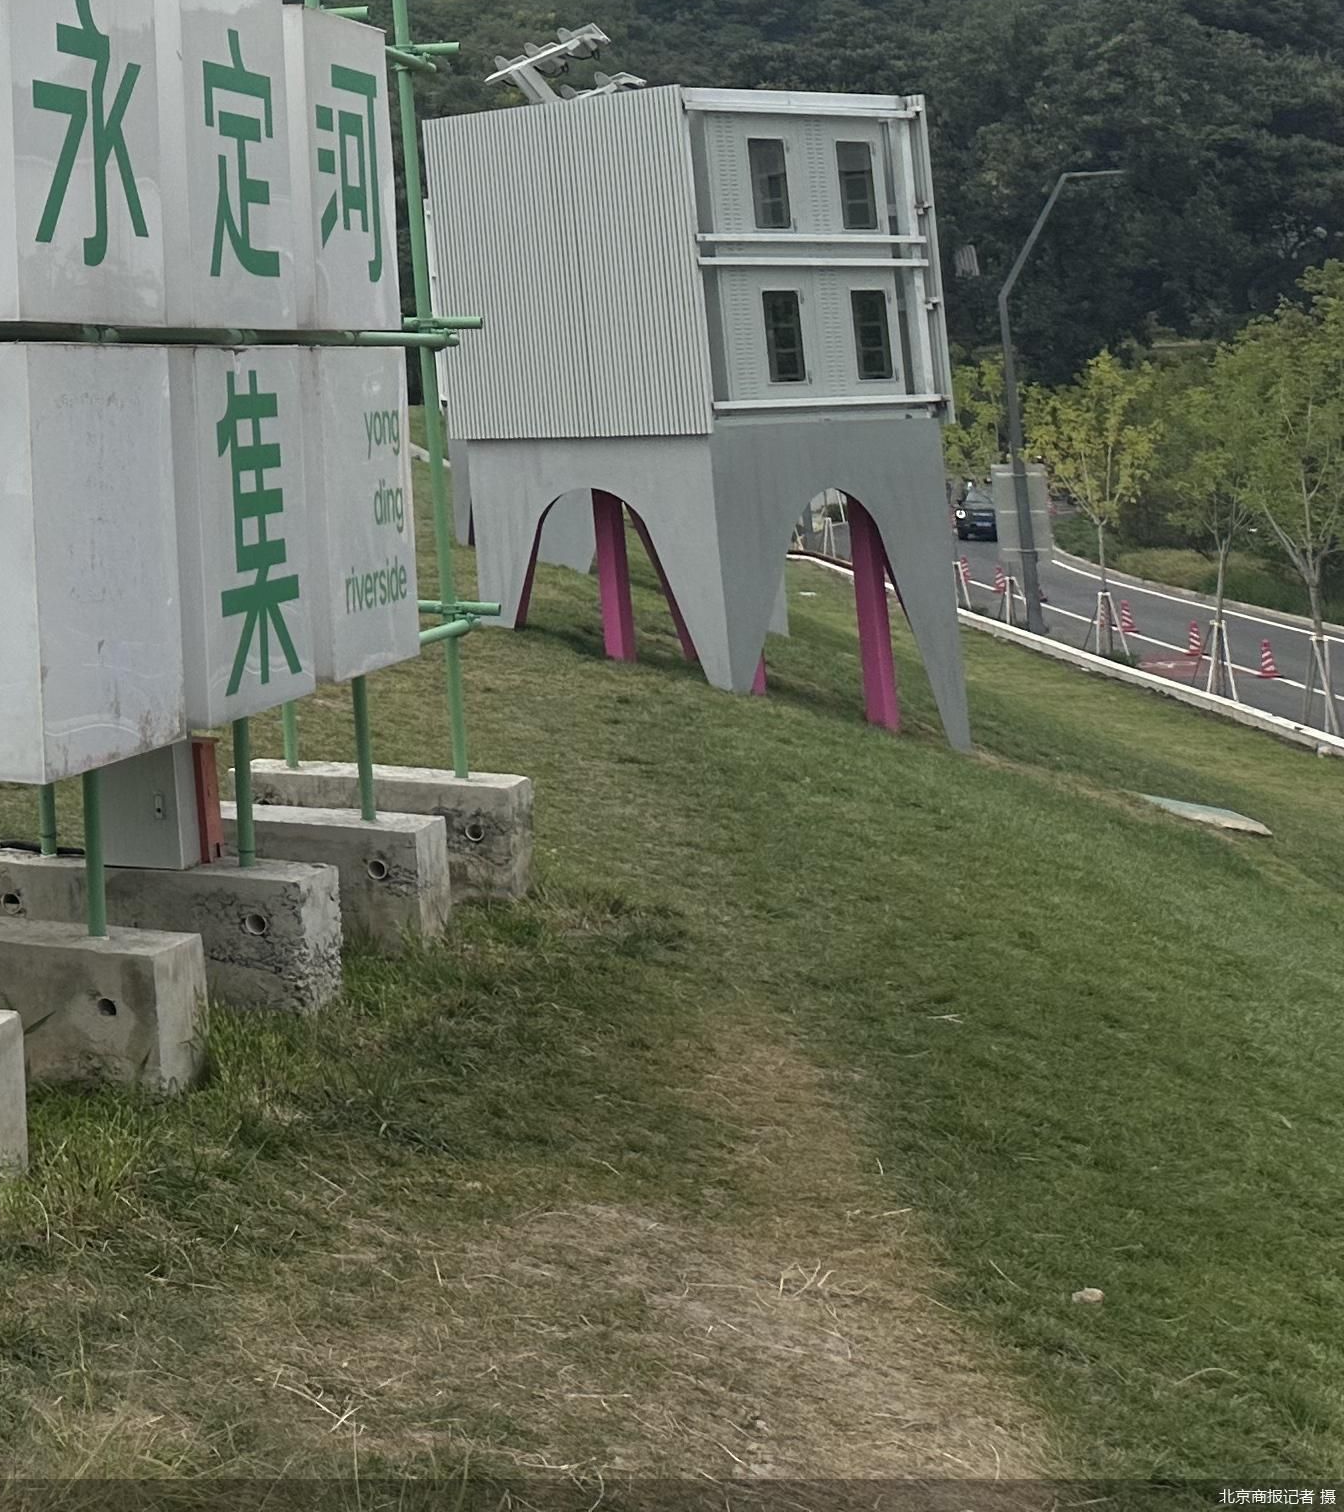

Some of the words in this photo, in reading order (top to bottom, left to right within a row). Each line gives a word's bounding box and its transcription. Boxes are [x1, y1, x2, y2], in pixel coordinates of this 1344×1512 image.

[364, 409, 400, 460] yong
[216, 369, 303, 697] 集
[374, 478, 404, 534] ding
[345, 555, 408, 614] riverside
